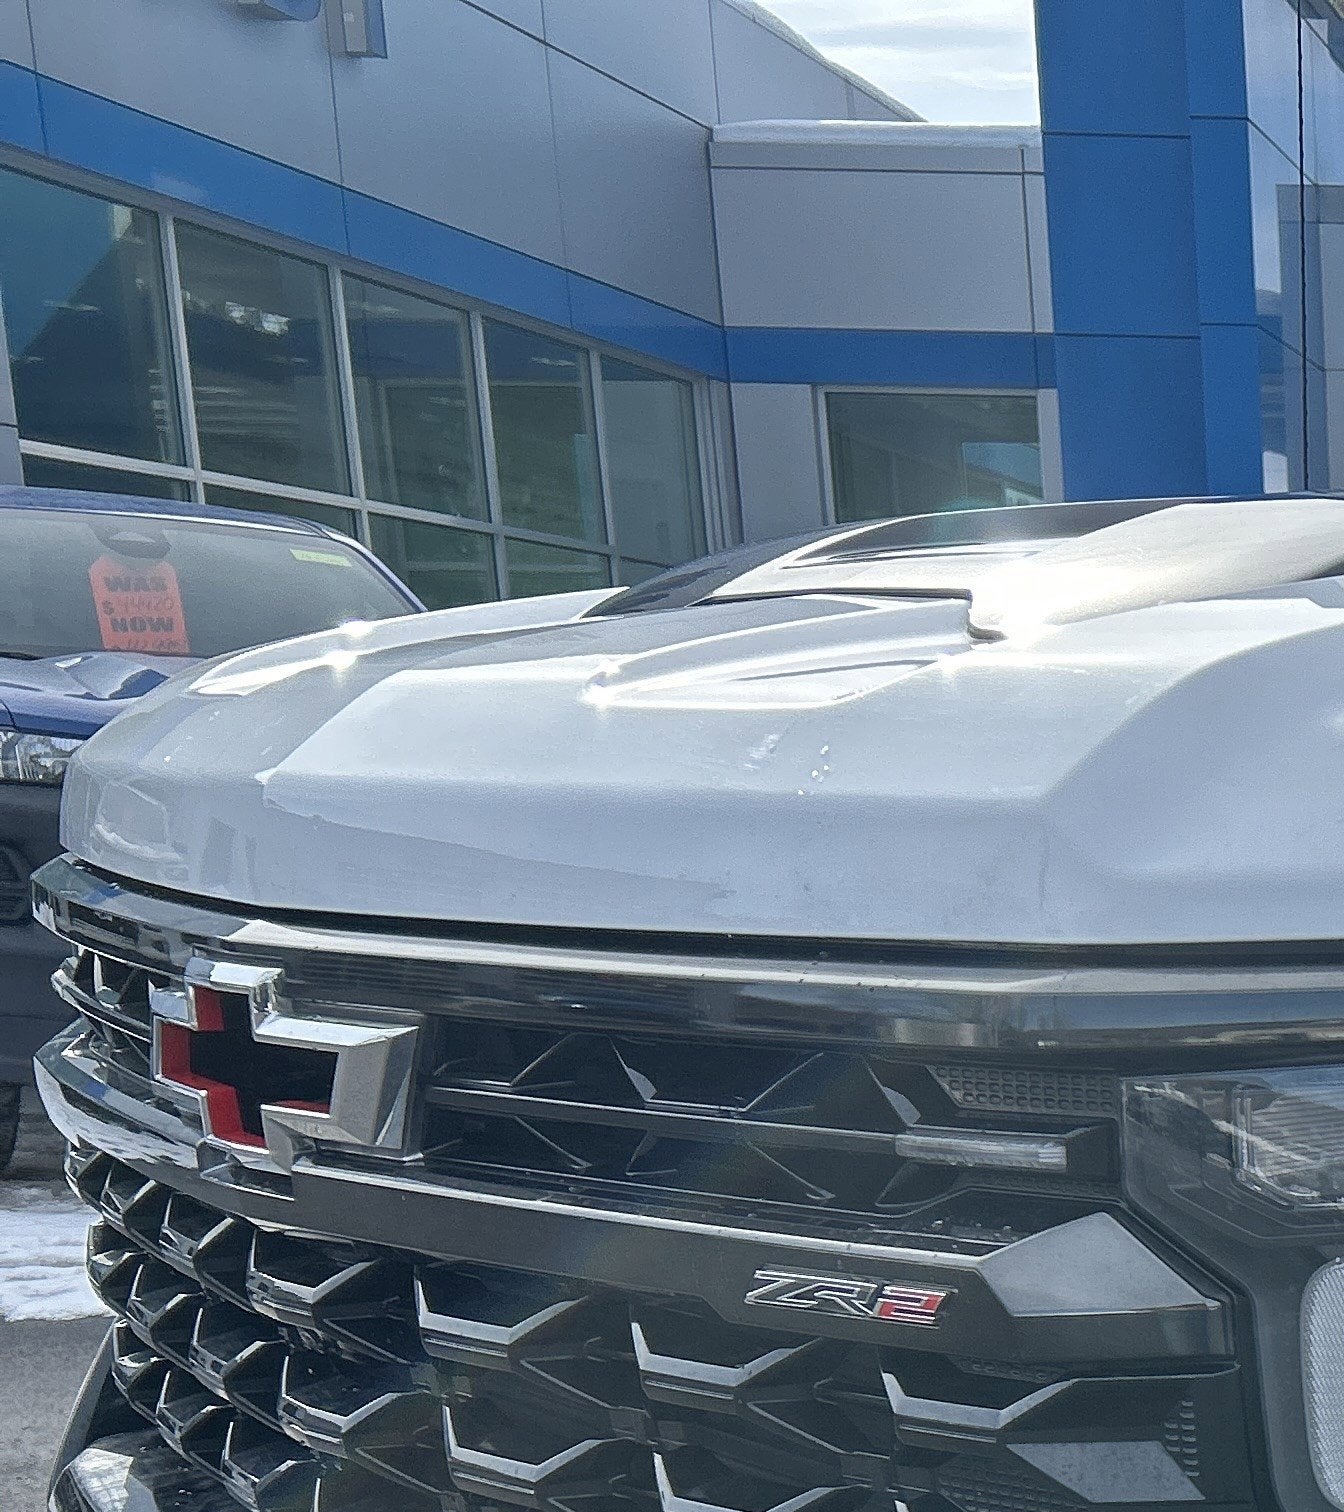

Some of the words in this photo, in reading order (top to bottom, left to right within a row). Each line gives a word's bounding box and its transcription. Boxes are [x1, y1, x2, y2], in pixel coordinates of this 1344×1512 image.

[104, 575, 168, 593] WAS
[111, 616, 174, 633] NOW
[744, 1264, 956, 1328] ZR2
